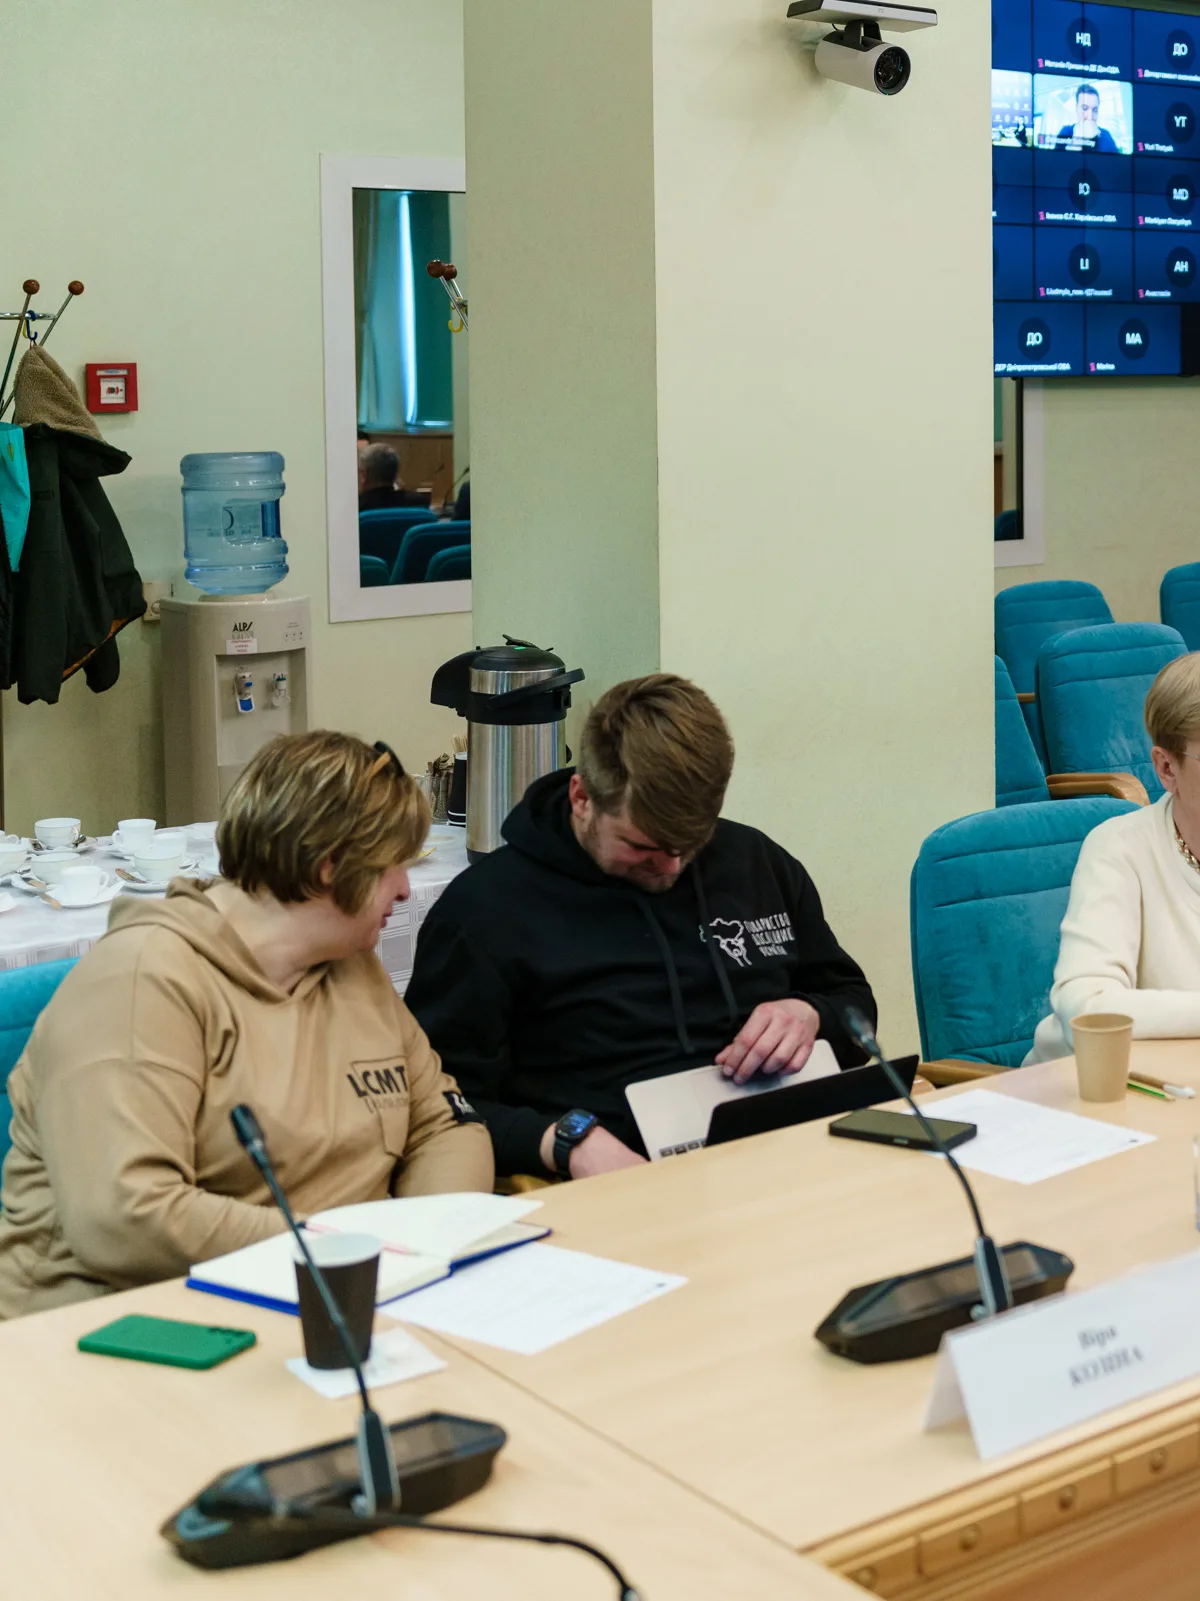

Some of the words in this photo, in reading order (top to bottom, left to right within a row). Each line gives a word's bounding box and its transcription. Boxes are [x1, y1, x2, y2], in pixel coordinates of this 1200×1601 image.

[1076, 32, 1091, 47] НД
[1172, 43, 1188, 56] ДО
[1174, 116, 1187, 128] YT
[1173, 188, 1189, 201] MD
[1080, 258, 1090, 270] LI
[1026, 332, 1043, 346] ДО
[346, 1065, 408, 1098] LCMT
